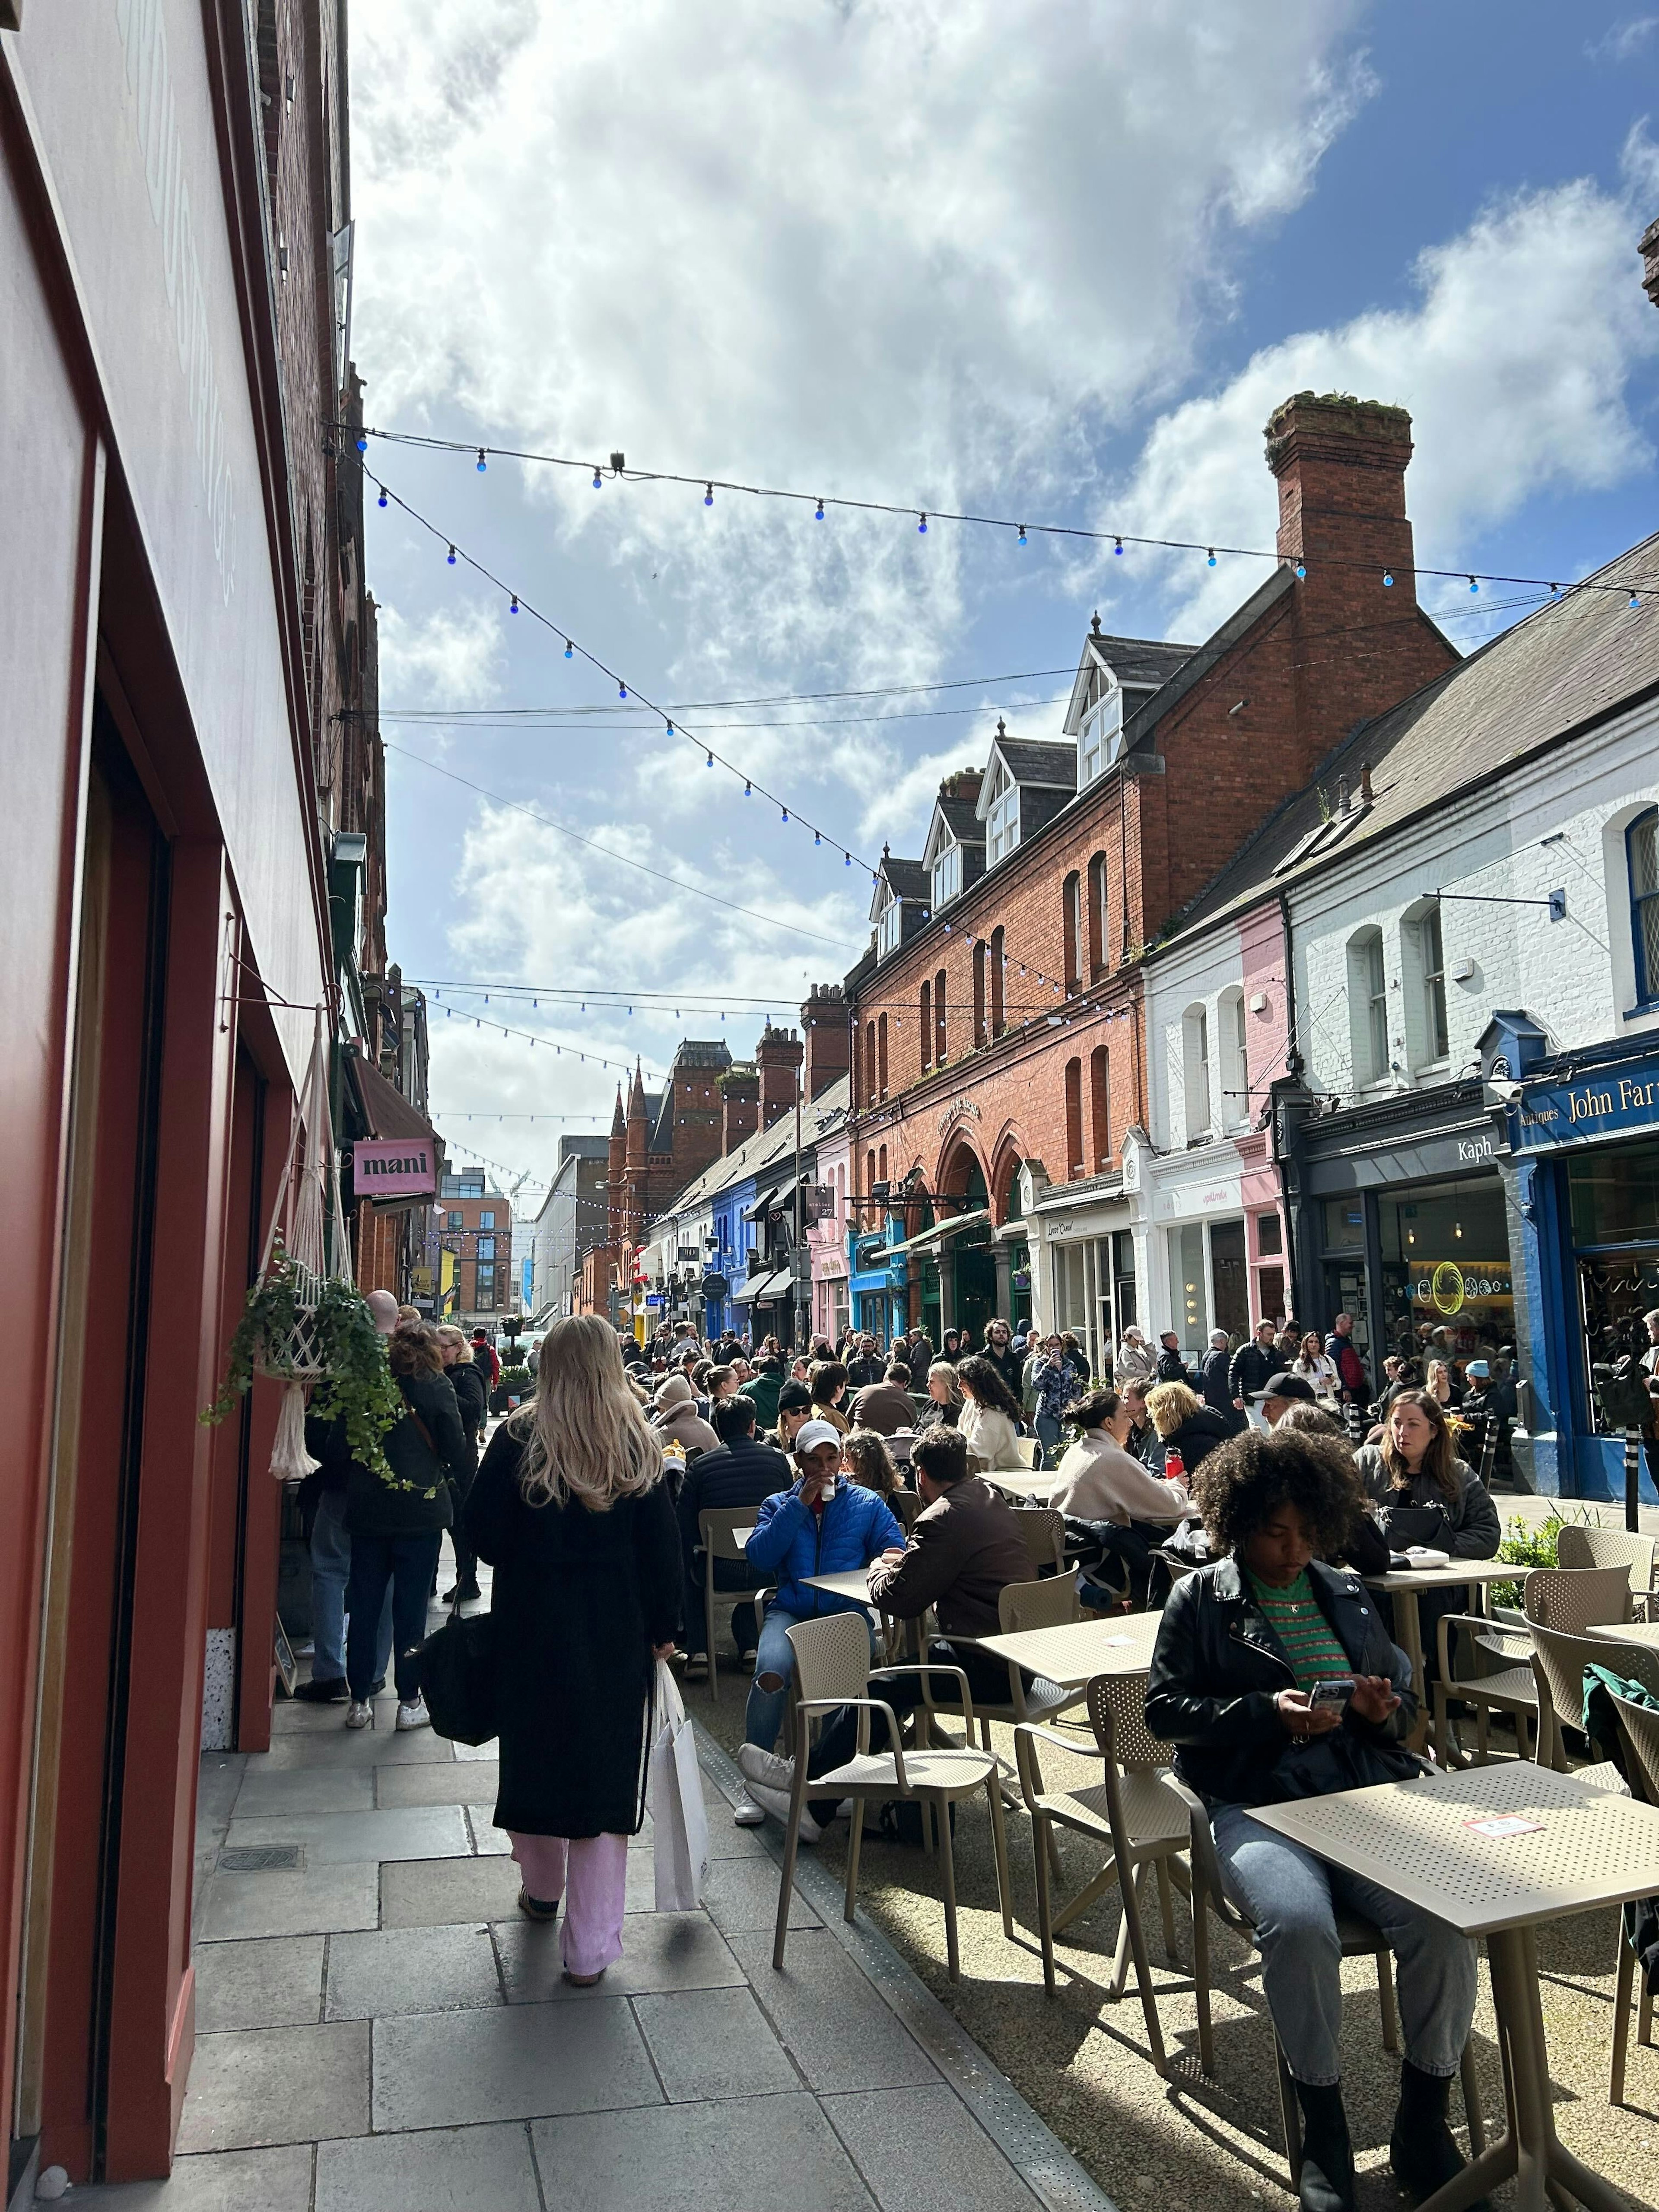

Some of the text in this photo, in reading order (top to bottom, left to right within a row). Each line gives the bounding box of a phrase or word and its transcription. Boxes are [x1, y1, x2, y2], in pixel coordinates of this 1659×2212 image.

[1520, 1079, 1659, 1127] Antiques John Far
[1457, 1136, 1493, 1163] Kaph
[363, 1152, 428, 1175] mani
[822, 1208, 833, 1217] 27
